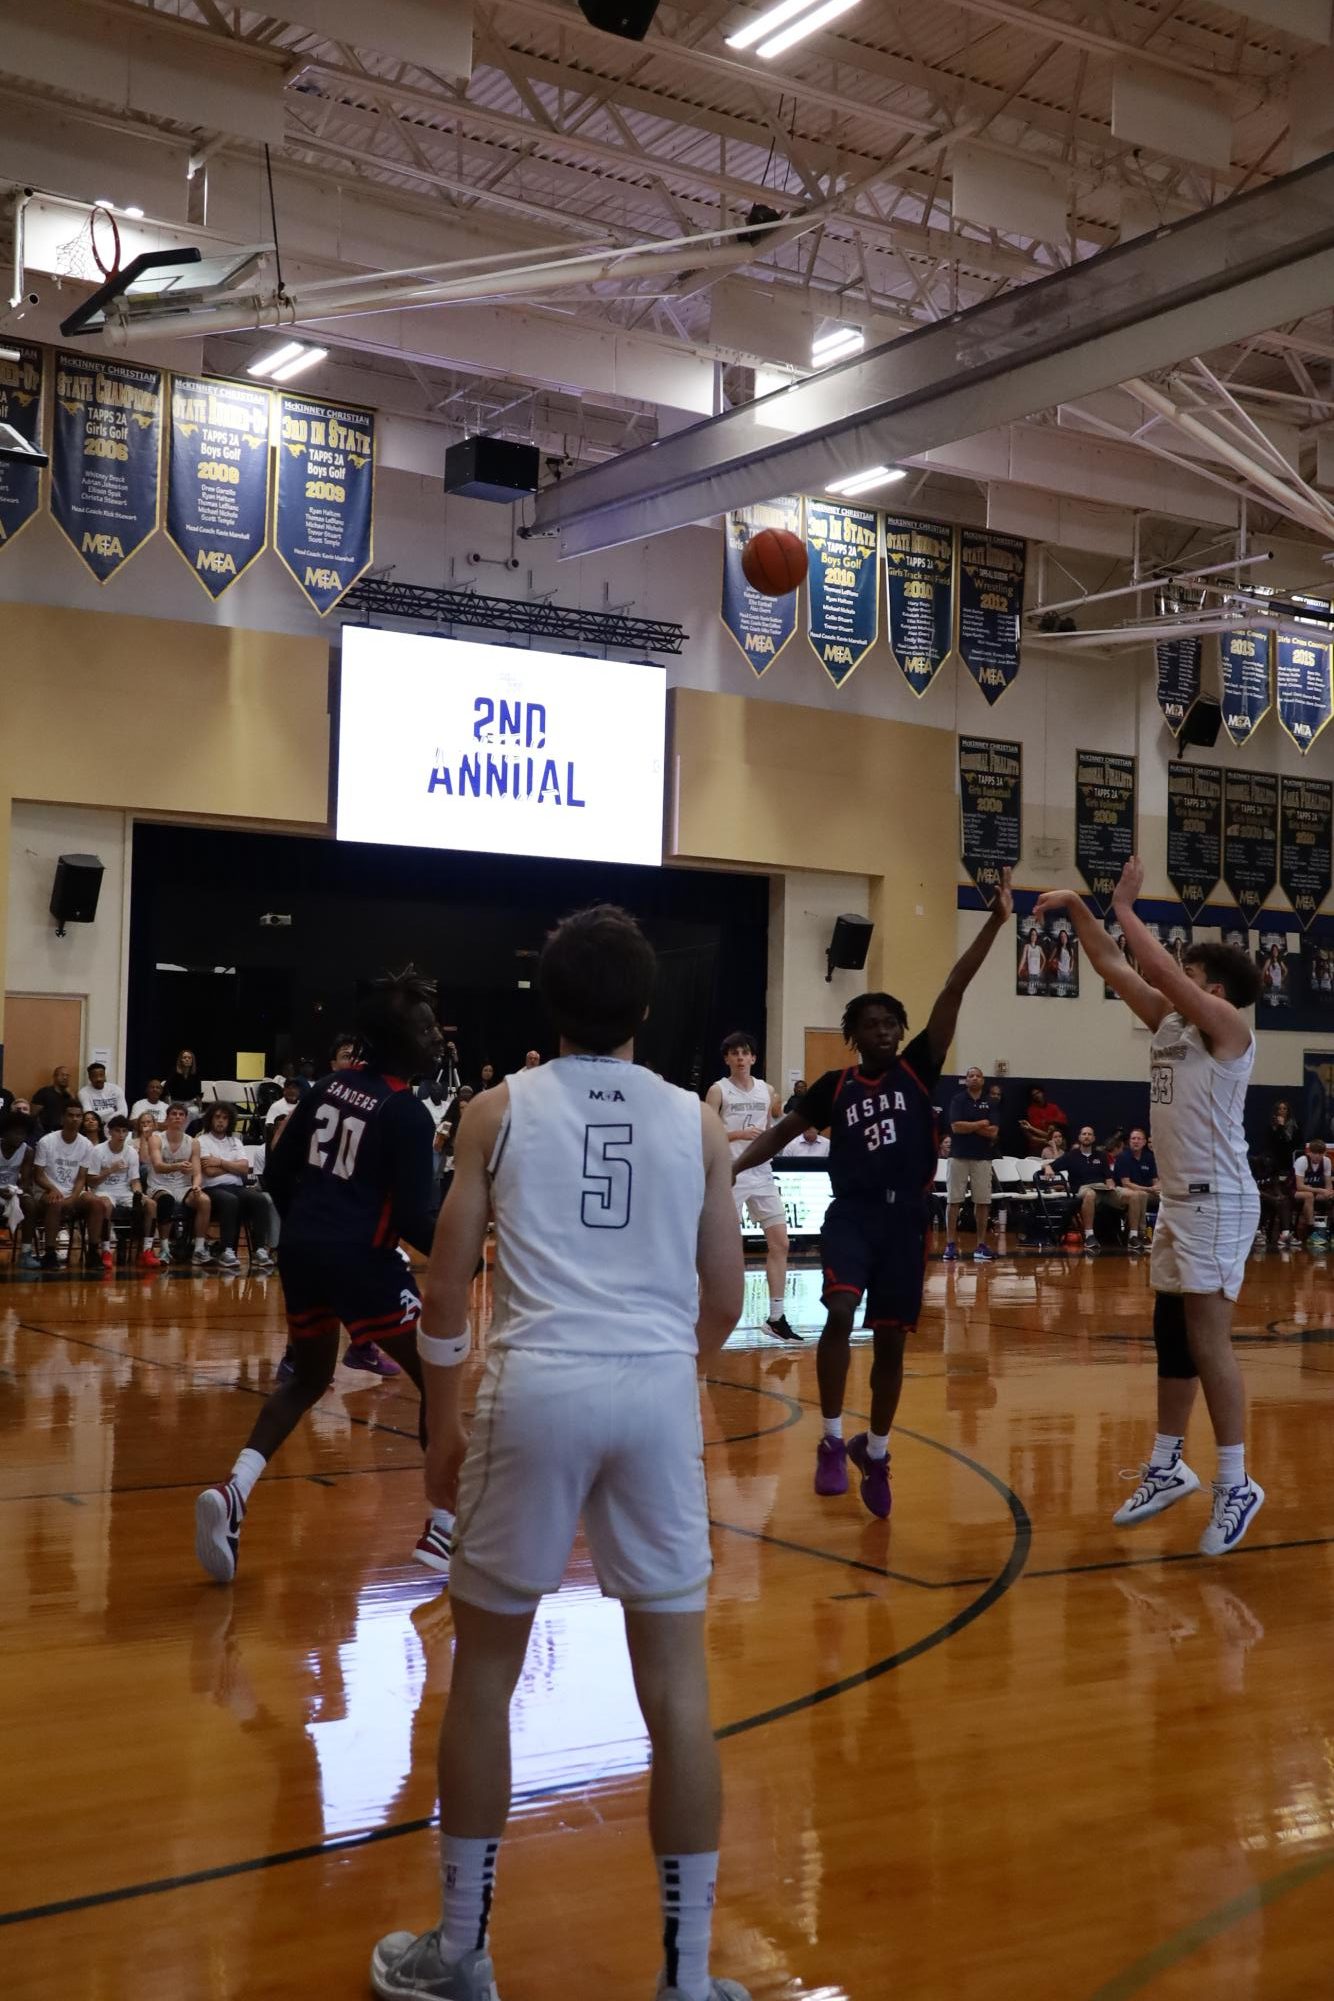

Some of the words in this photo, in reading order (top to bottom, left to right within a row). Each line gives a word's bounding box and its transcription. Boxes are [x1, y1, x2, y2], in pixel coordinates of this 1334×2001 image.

[60, 356, 106, 373] McKINNEY
[108, 365, 156, 383] CHRISTIAN
[57, 371, 94, 401] STATE
[88, 408, 114, 423] TAPPS
[116, 413, 127, 425] 2A
[284, 400, 326, 417] McKINNEY
[327, 410, 369, 426] CHRISTIAN
[86, 422, 107, 436] Girls
[109, 426, 128, 440] Golf
[202, 429, 227, 444] TAPPS
[229, 434, 239, 446] 2A
[282, 415, 308, 443] 3RD
[310, 420, 325, 445] IN
[328, 418, 371, 454] STATE
[201, 442, 220, 459] Boys
[223, 447, 242, 461] Golf
[309, 448, 333, 464] TAPPS
[334, 454, 344, 466] 2A
[308, 462, 327, 478] Boys
[329, 466, 346, 480] Golf
[844, 516, 876, 547] STATE
[821, 552, 841, 567] Boys
[843, 557, 863, 569] Golf
[827, 542, 847, 554] TAPPS
[848, 545, 857, 556] 2A
[906, 556, 925, 568] TAPPS
[904, 570, 922, 579] Track
[975, 578, 1014, 598] Wrestling
[474, 697, 546, 748] 2ND
[428, 748, 585, 807] ANNUAL
[326, 1080, 378, 1111] SANDERS
[846, 1091, 907, 1127] HSAA
[308, 1103, 367, 1180] 20
[864, 1119, 896, 1151] 33
[581, 1123, 632, 1229] 5
